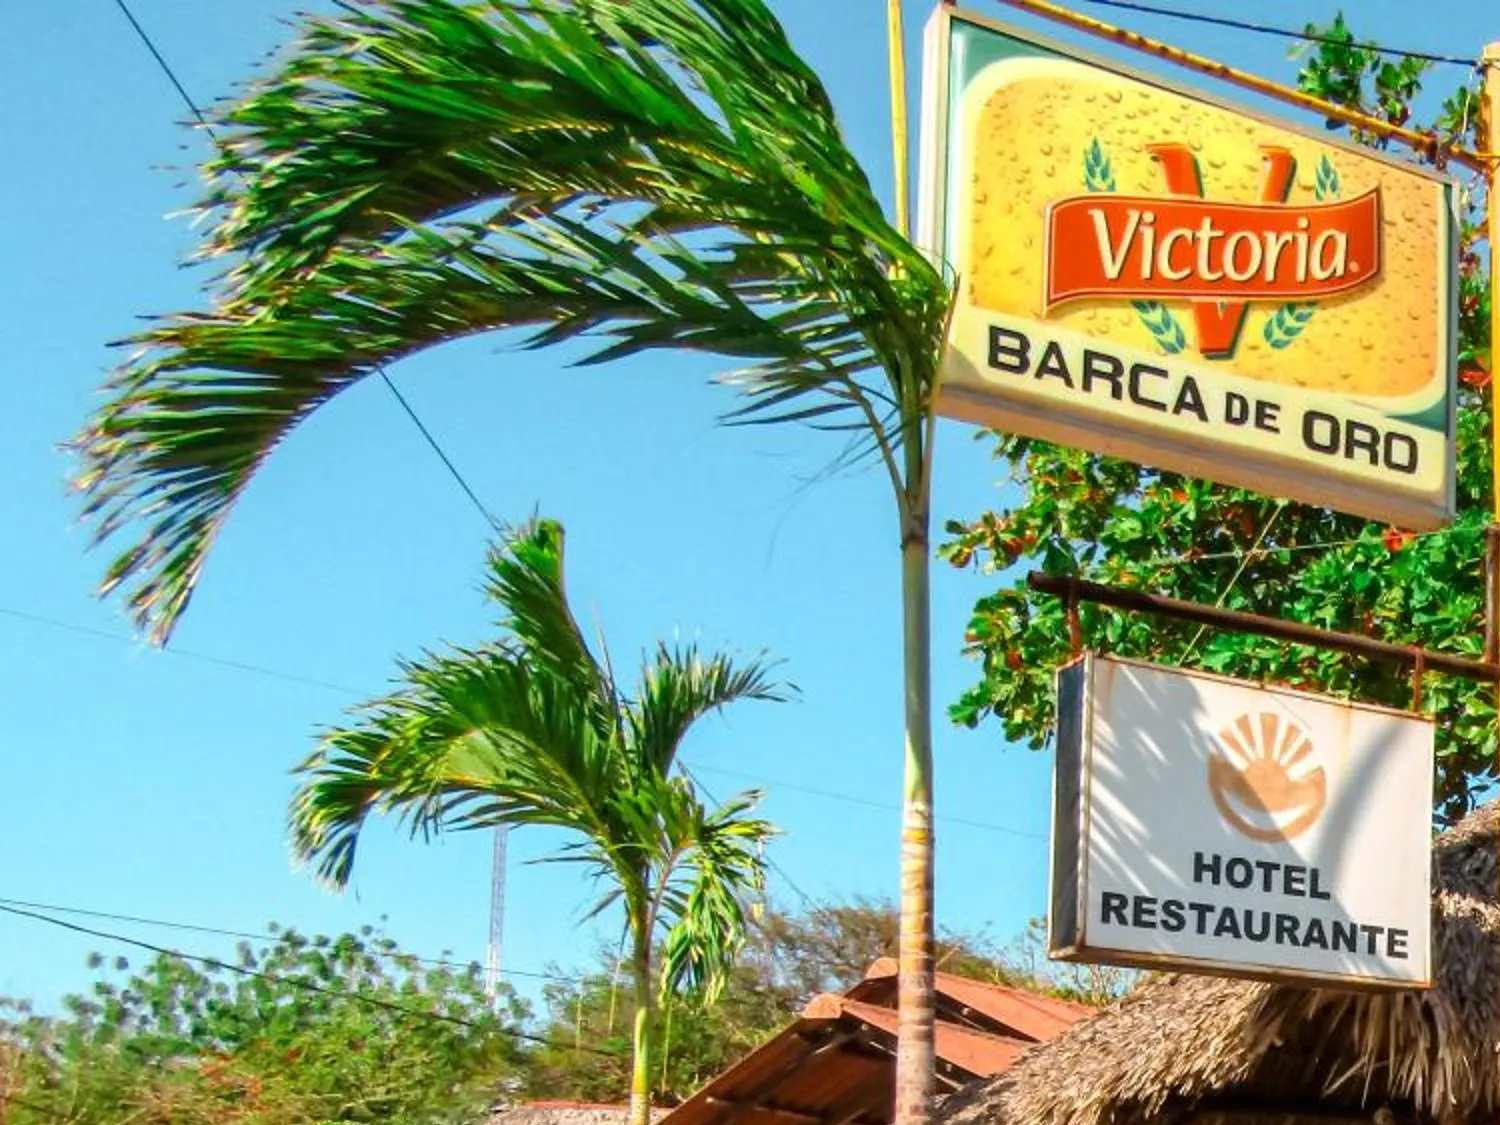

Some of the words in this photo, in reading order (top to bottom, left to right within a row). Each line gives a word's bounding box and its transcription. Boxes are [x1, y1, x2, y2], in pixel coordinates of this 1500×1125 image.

[1088, 208, 1349, 285] Victoria
[987, 325, 1209, 423] BARCA
[1224, 392, 1281, 434] DE
[1302, 410, 1419, 475] ORO
[1192, 851, 1332, 902] HOTEL
[1100, 891, 1409, 960] RESTAURANTE
